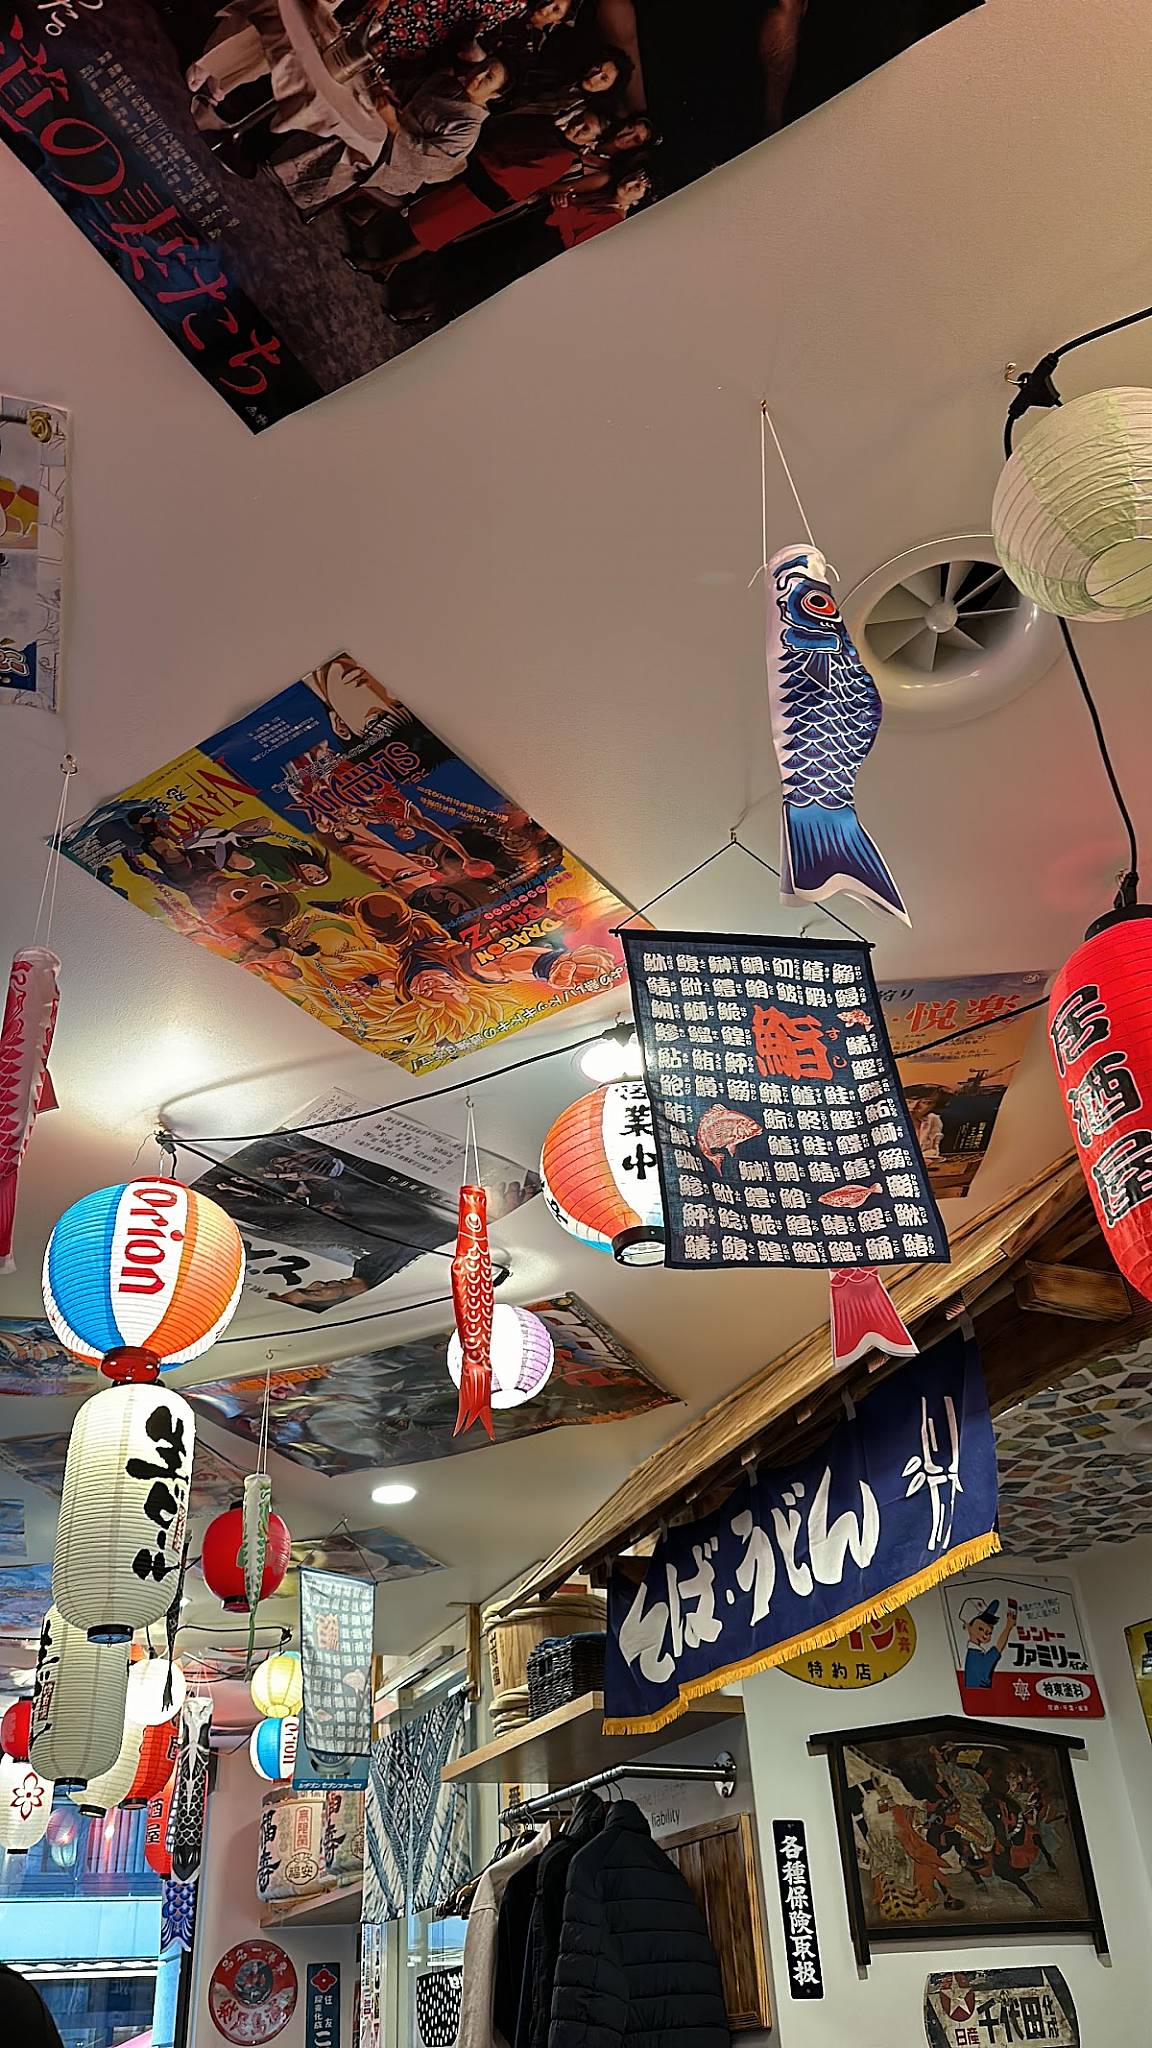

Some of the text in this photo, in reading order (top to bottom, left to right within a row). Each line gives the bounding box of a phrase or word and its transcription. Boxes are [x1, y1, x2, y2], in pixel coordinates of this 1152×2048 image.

[459, 922, 492, 951] Z
[473, 917, 564, 967] DRAGON
[741, 956, 764, 974] 鯛
[657, 1048, 682, 1068] 鮎
[692, 1049, 715, 1070] 鮪
[824, 1086, 850, 1105] 鮭
[803, 1136, 828, 1155] 鮭
[773, 1162, 800, 1182] 鯛
[117, 1187, 187, 1295] Orion
[619, 1465, 880, 1683] そば・うどん
[1017, 1626, 1066, 1642] シントー
[1007, 1642, 1081, 1669] ファミリー
[807, 1661, 872, 1681] 特約店
[780, 1836, 820, 1986] 各種保険取扱
[976, 1997, 1046, 2045] 千代田
[955, 2027, 981, 2046] 日産
